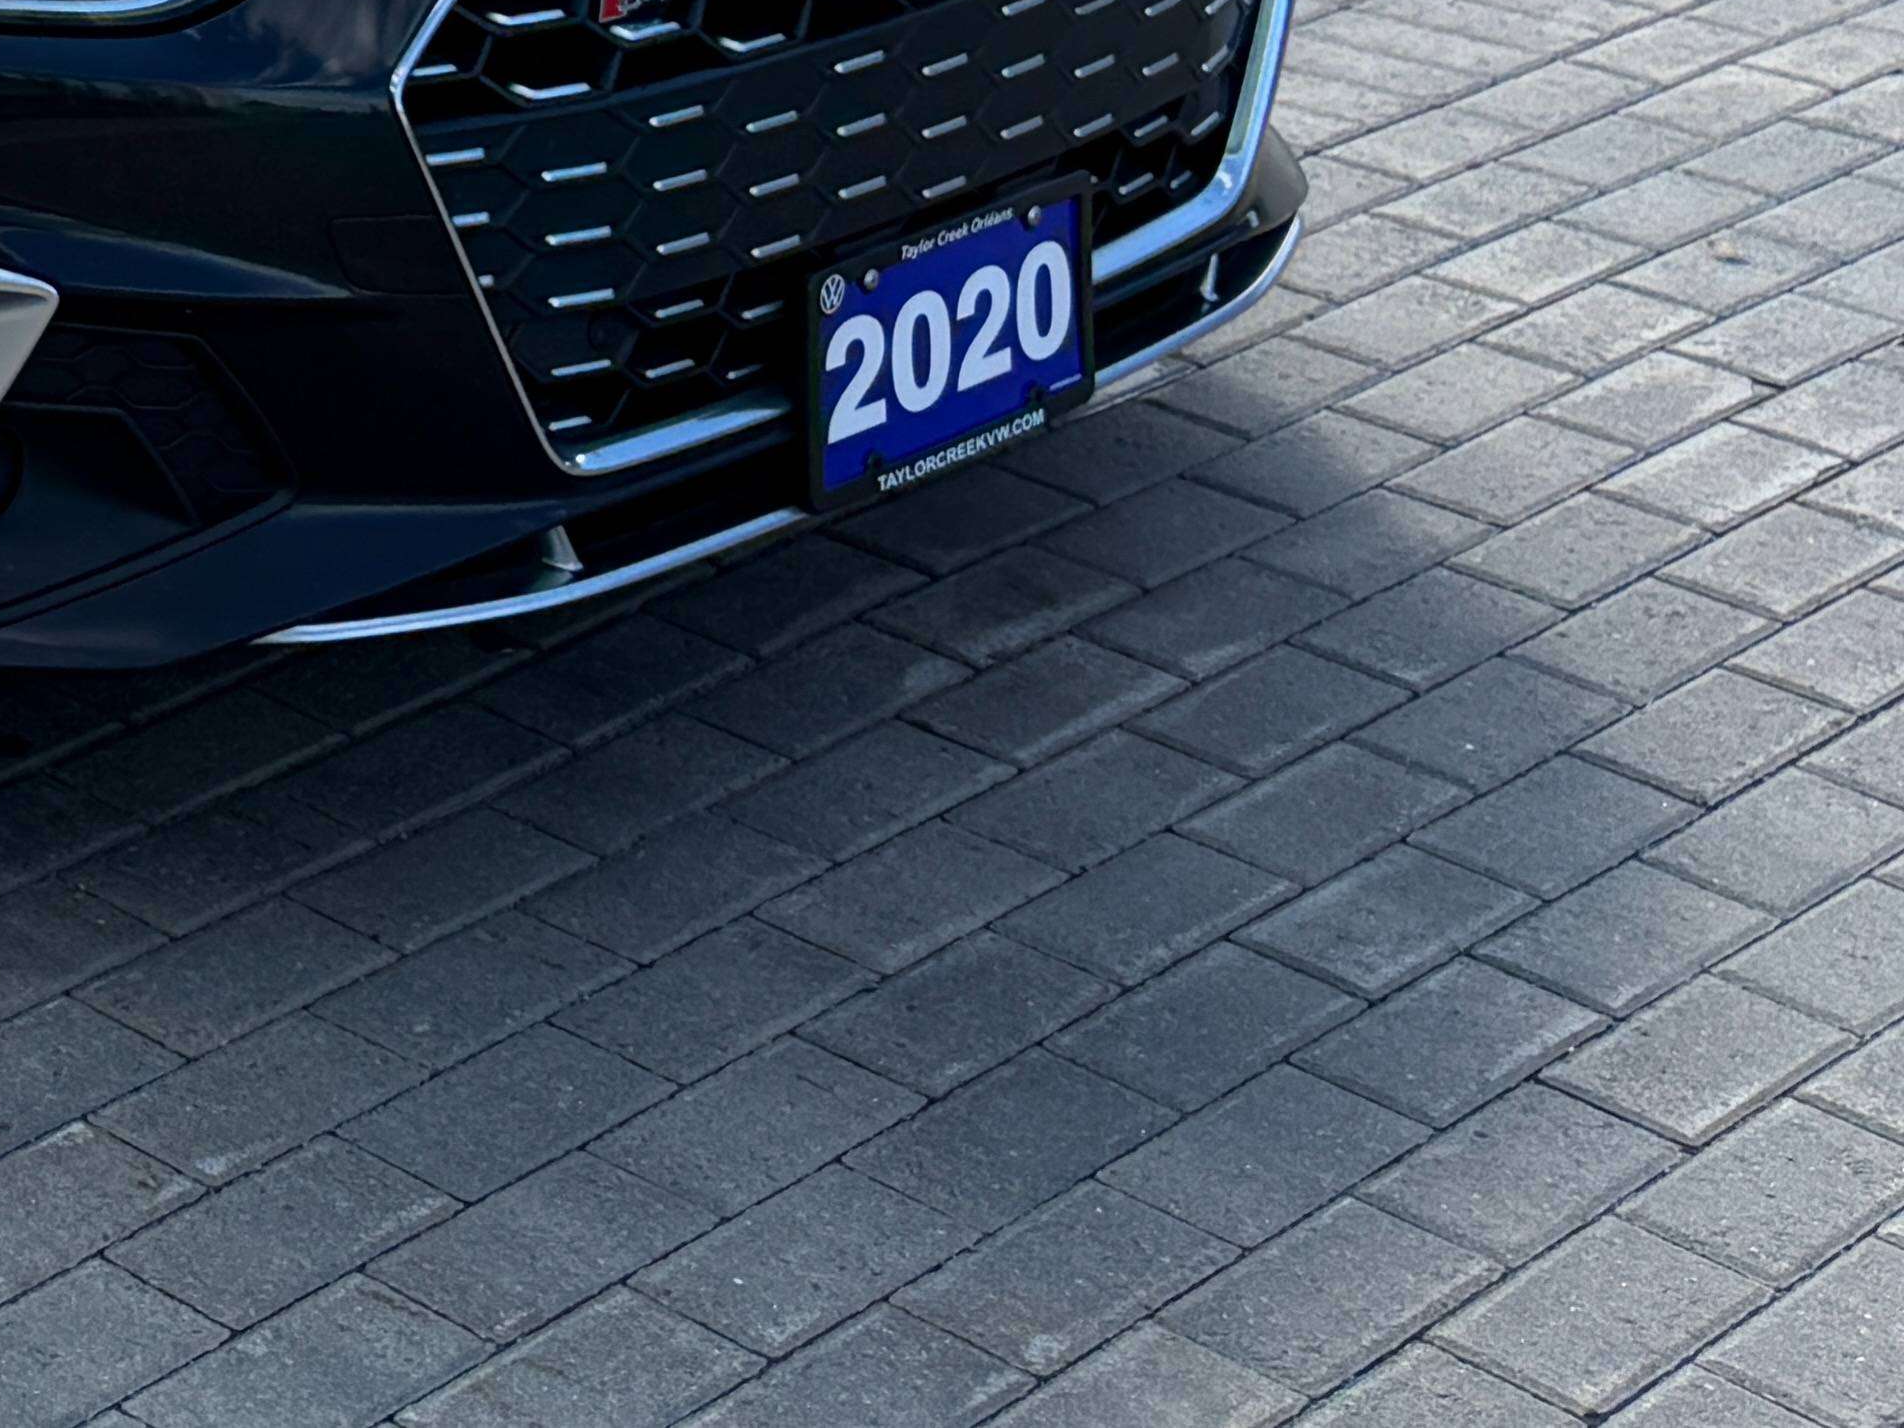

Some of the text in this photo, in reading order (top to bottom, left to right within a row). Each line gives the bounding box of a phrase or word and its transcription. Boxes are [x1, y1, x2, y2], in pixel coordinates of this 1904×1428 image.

[901, 238, 934, 261] Taylor
[937, 225, 969, 247] Creek
[825, 240, 1072, 445] 2020
[877, 408, 1045, 492] TAYLORCREEKVW.COM
